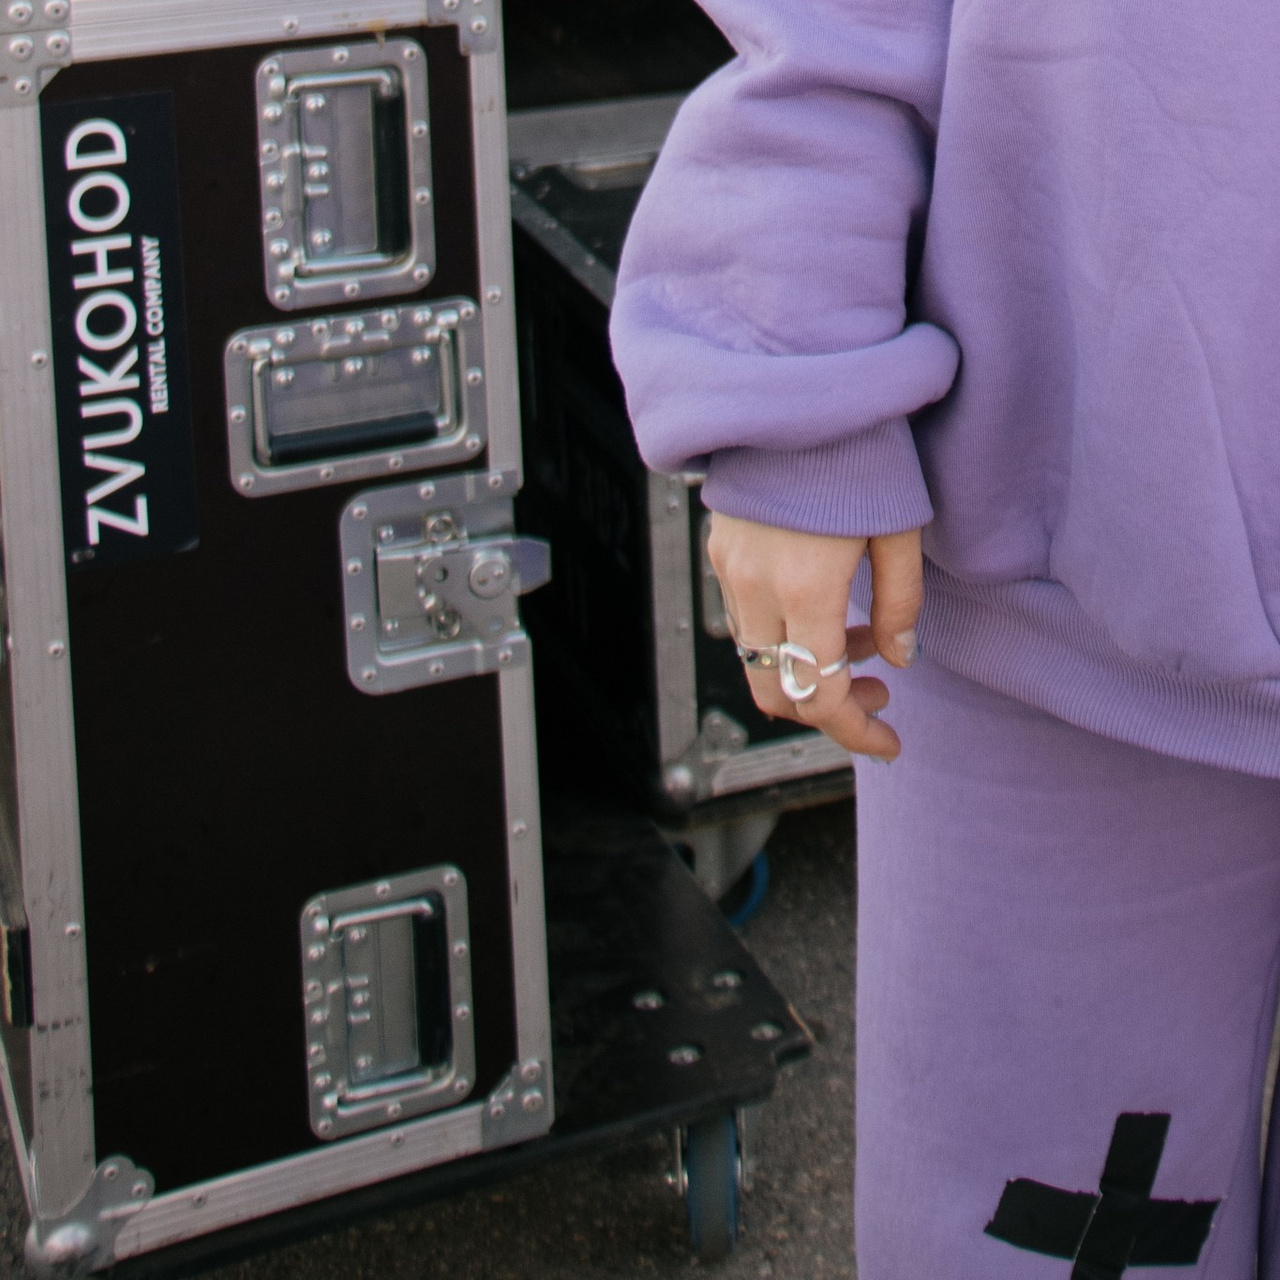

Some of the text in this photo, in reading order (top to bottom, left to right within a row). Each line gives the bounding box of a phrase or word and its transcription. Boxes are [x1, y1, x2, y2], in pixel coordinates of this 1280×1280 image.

[65, 117, 149, 546] ZVUKOHOD
[142, 235, 169, 414] RENTAL COMPANY
